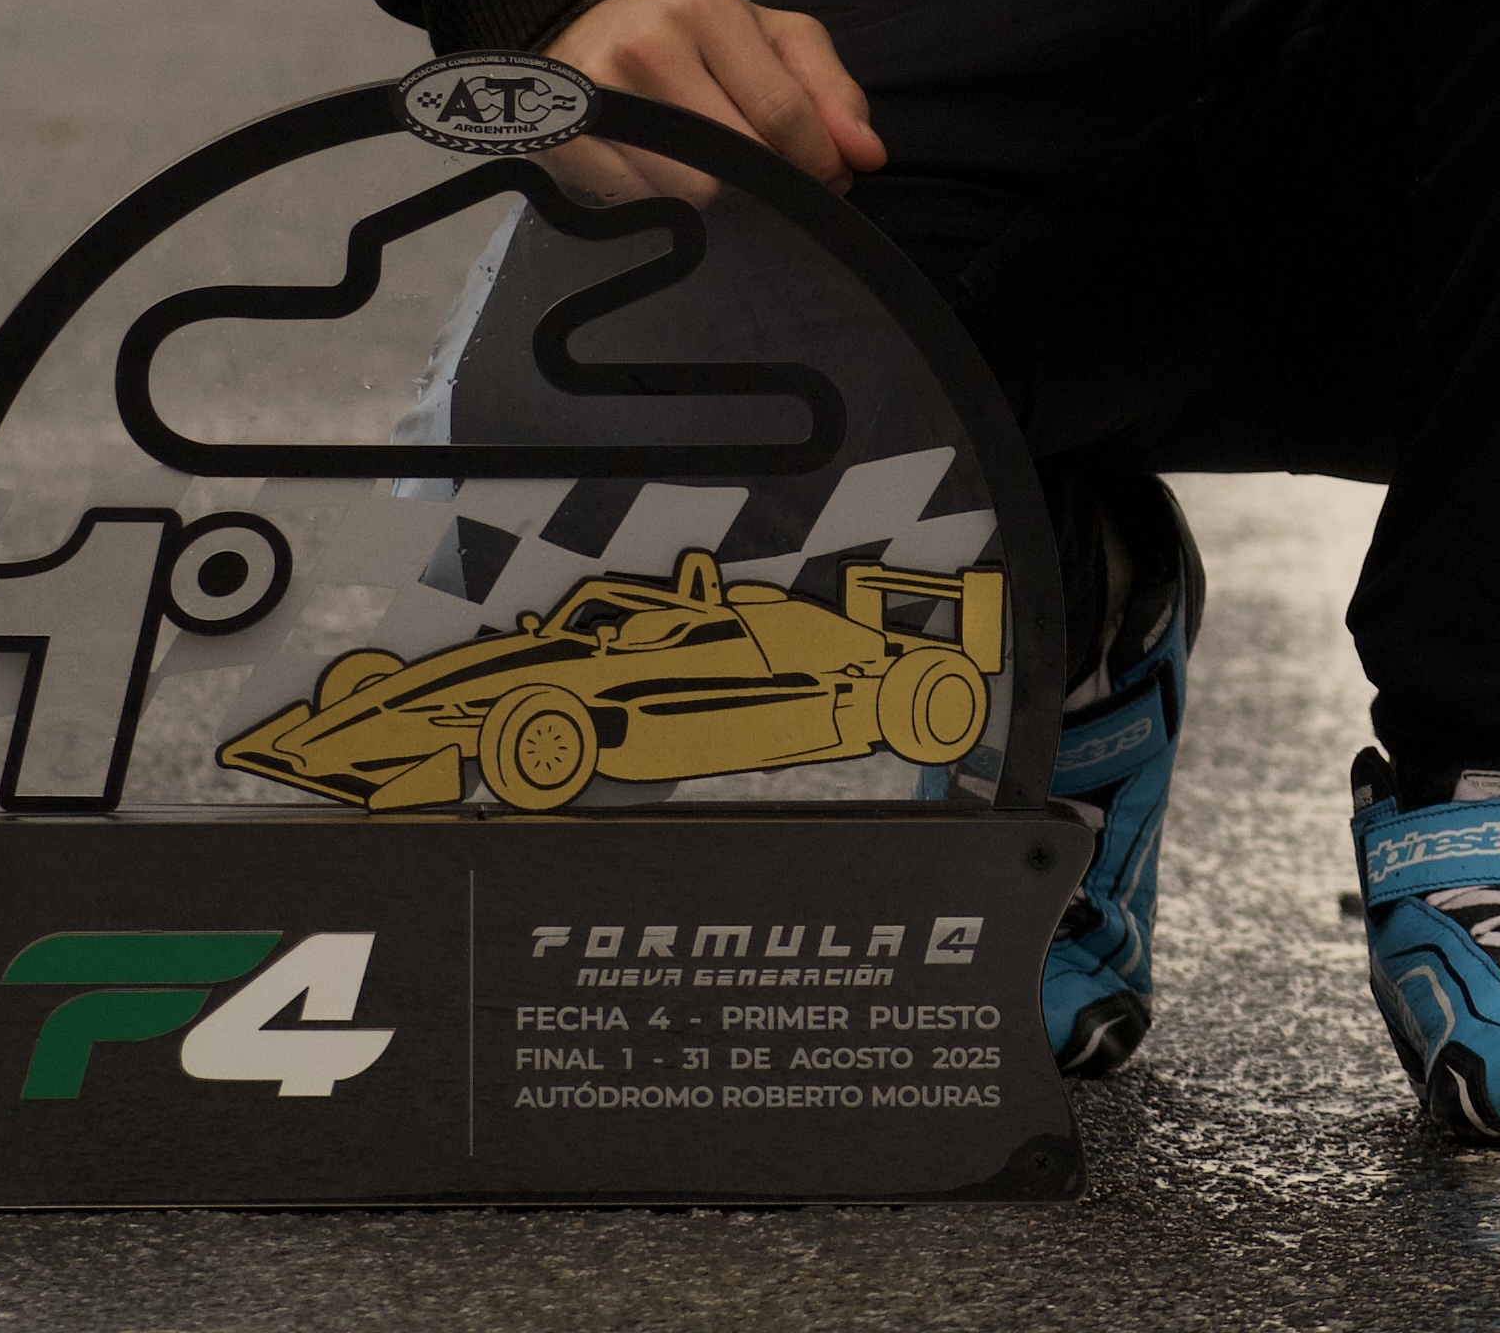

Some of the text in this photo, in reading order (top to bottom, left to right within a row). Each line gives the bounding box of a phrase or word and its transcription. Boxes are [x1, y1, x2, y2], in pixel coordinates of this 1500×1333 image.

[509, 56, 548, 69] TURISMO
[453, 123, 539, 134] ARGENTINA
[532, 917, 984, 964] FORMULA 4
[577, 968, 682, 986] NUEVA
[0, 933, 396, 1100] F4
[517, 1006, 629, 1030] FECHA
[648, 1007, 670, 1030] 4
[722, 1006, 849, 1030] PRIMER
[870, 1005, 1000, 1030] PUESTO
[516, 1048, 604, 1069] FINAL
[622, 1049, 633, 1069] 1
[682, 1048, 710, 1069] 31
[730, 1048, 771, 1069] DE
[790, 1047, 913, 1069] AGOSTO
[932, 1047, 1000, 1069] 2025
[515, 1081, 1000, 1108] AUTÓDROMO ROBERTO MOURAS
